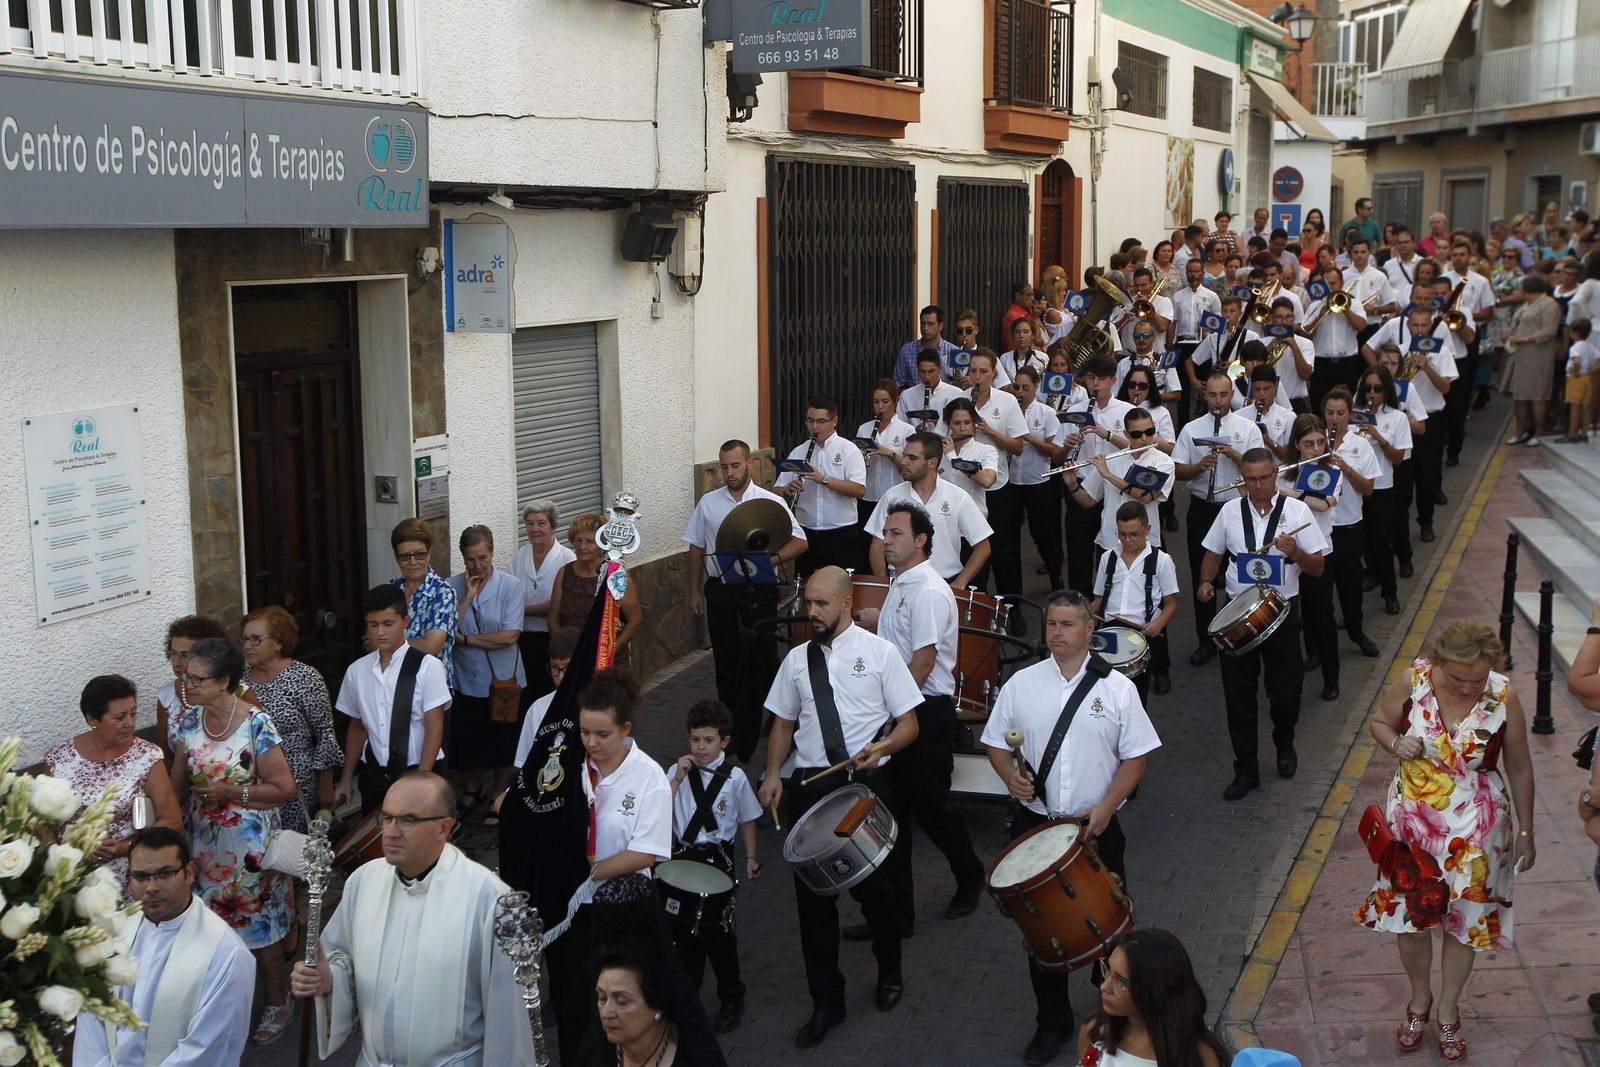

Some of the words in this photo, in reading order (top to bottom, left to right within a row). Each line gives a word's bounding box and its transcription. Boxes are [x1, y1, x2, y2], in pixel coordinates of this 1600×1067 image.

[764, 0, 828, 25] Real
[739, 32, 764, 46] Centro
[765, 32, 775, 44] de
[817, 27, 823, 40] &
[824, 26, 857, 42] Terapias
[758, 51, 781, 64] 666
[785, 50, 800, 62] 93
[804, 49, 818, 62] 51
[824, 47, 839, 61] 48
[1, 116, 87, 174] Centro
[95, 123, 124, 175] de
[132, 125, 242, 190] Psicología
[249, 132, 263, 179] &
[268, 134, 345, 191] Terapias
[357, 175, 422, 212] Real
[457, 263, 494, 283] adra
[70, 436, 99, 453] Real
